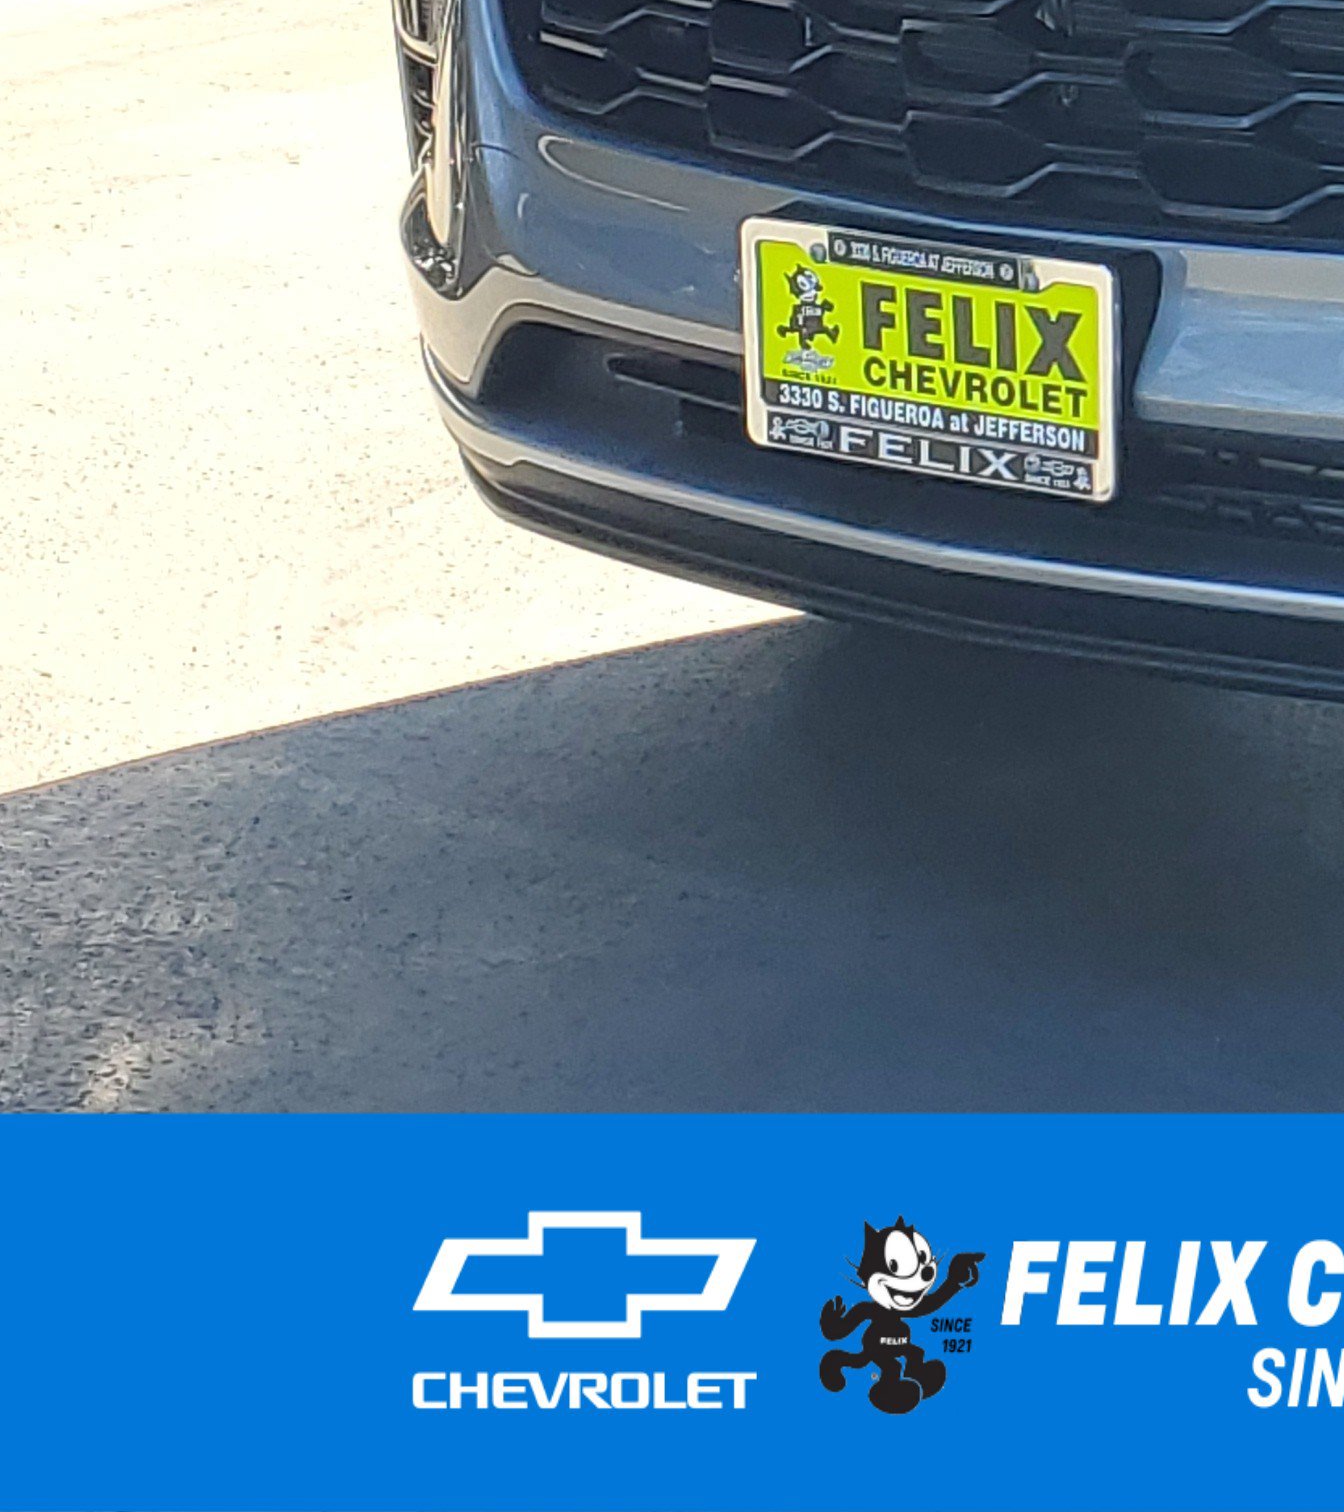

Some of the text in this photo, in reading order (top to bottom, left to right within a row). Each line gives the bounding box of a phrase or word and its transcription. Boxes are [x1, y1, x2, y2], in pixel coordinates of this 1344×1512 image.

[861, 280, 1087, 384] FELIX
[779, 383, 1085, 452] 3330 S. FIGUEROA at JEFFERSON
[864, 356, 1088, 418] CHEVROLET
[839, 425, 1020, 482] FELIX
